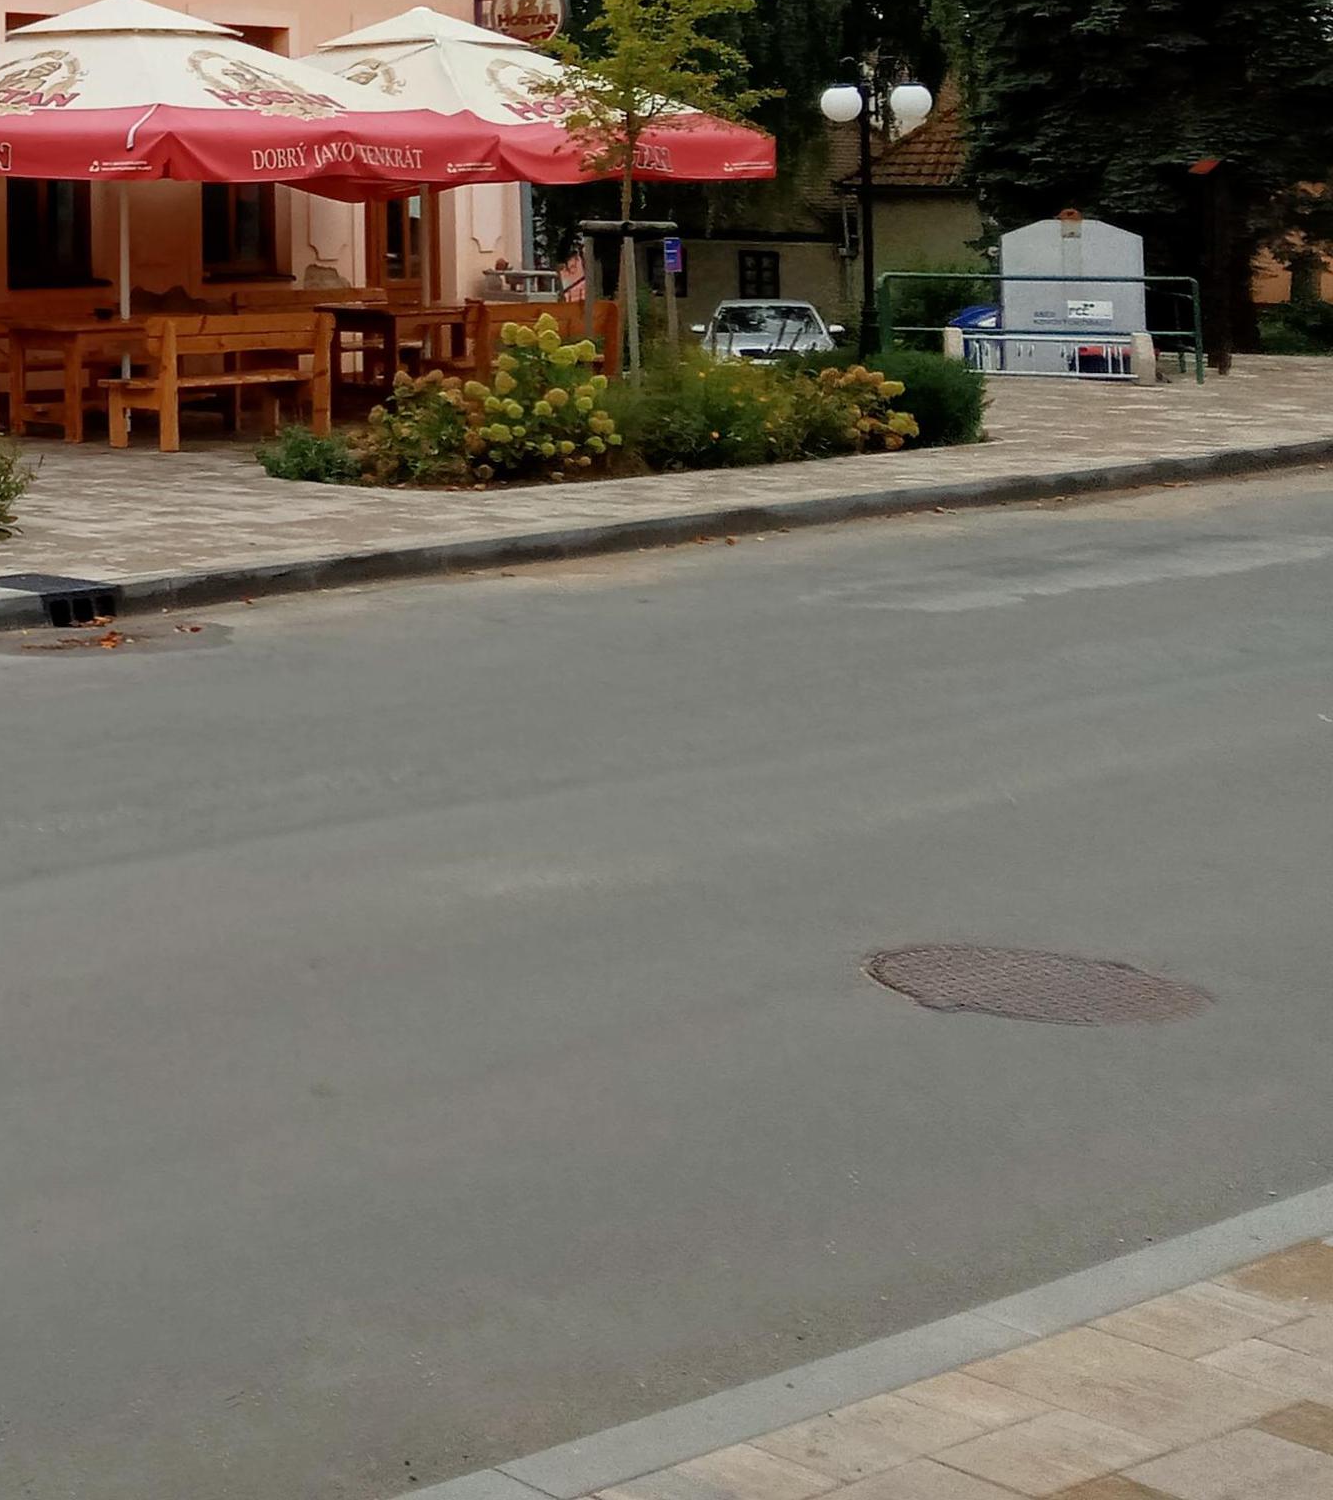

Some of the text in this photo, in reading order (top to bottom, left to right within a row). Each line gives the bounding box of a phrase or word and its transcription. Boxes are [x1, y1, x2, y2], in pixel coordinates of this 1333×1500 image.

[497, 14, 559, 27] HOSTAN
[251, 142, 307, 170] DOBRÝ
[313, 141, 355, 168] JAKO
[356, 144, 423, 169] TENKRÁT
